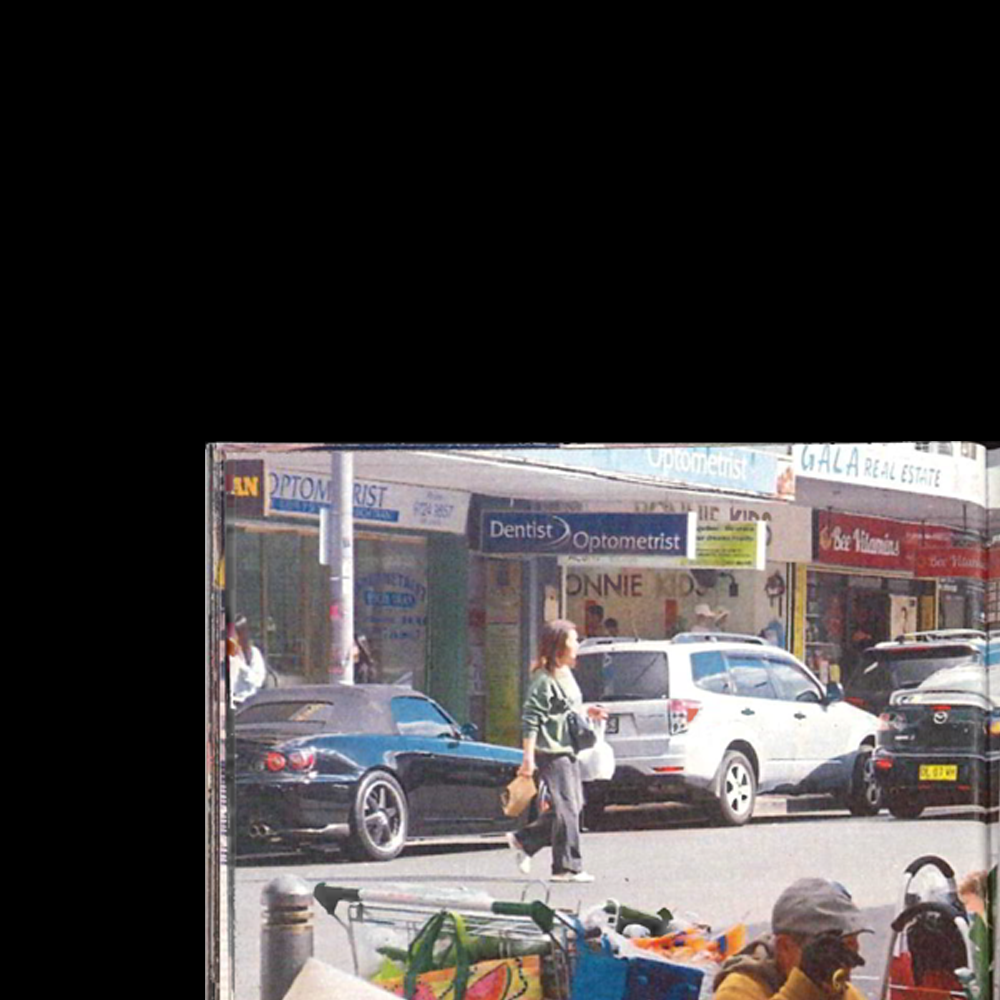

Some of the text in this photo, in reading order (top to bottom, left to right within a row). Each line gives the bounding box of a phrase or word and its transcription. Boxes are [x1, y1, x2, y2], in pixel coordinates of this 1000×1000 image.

[647, 447, 747, 480] Optometrist
[801, 445, 942, 487] GALA REAL ESTATE
[268, 473, 388, 508] OPTOMRIST
[490, 520, 681, 552] Dentist Optometrist
[831, 526, 900, 557] Bee Vitamins
[567, 573, 644, 597] ONNIE
